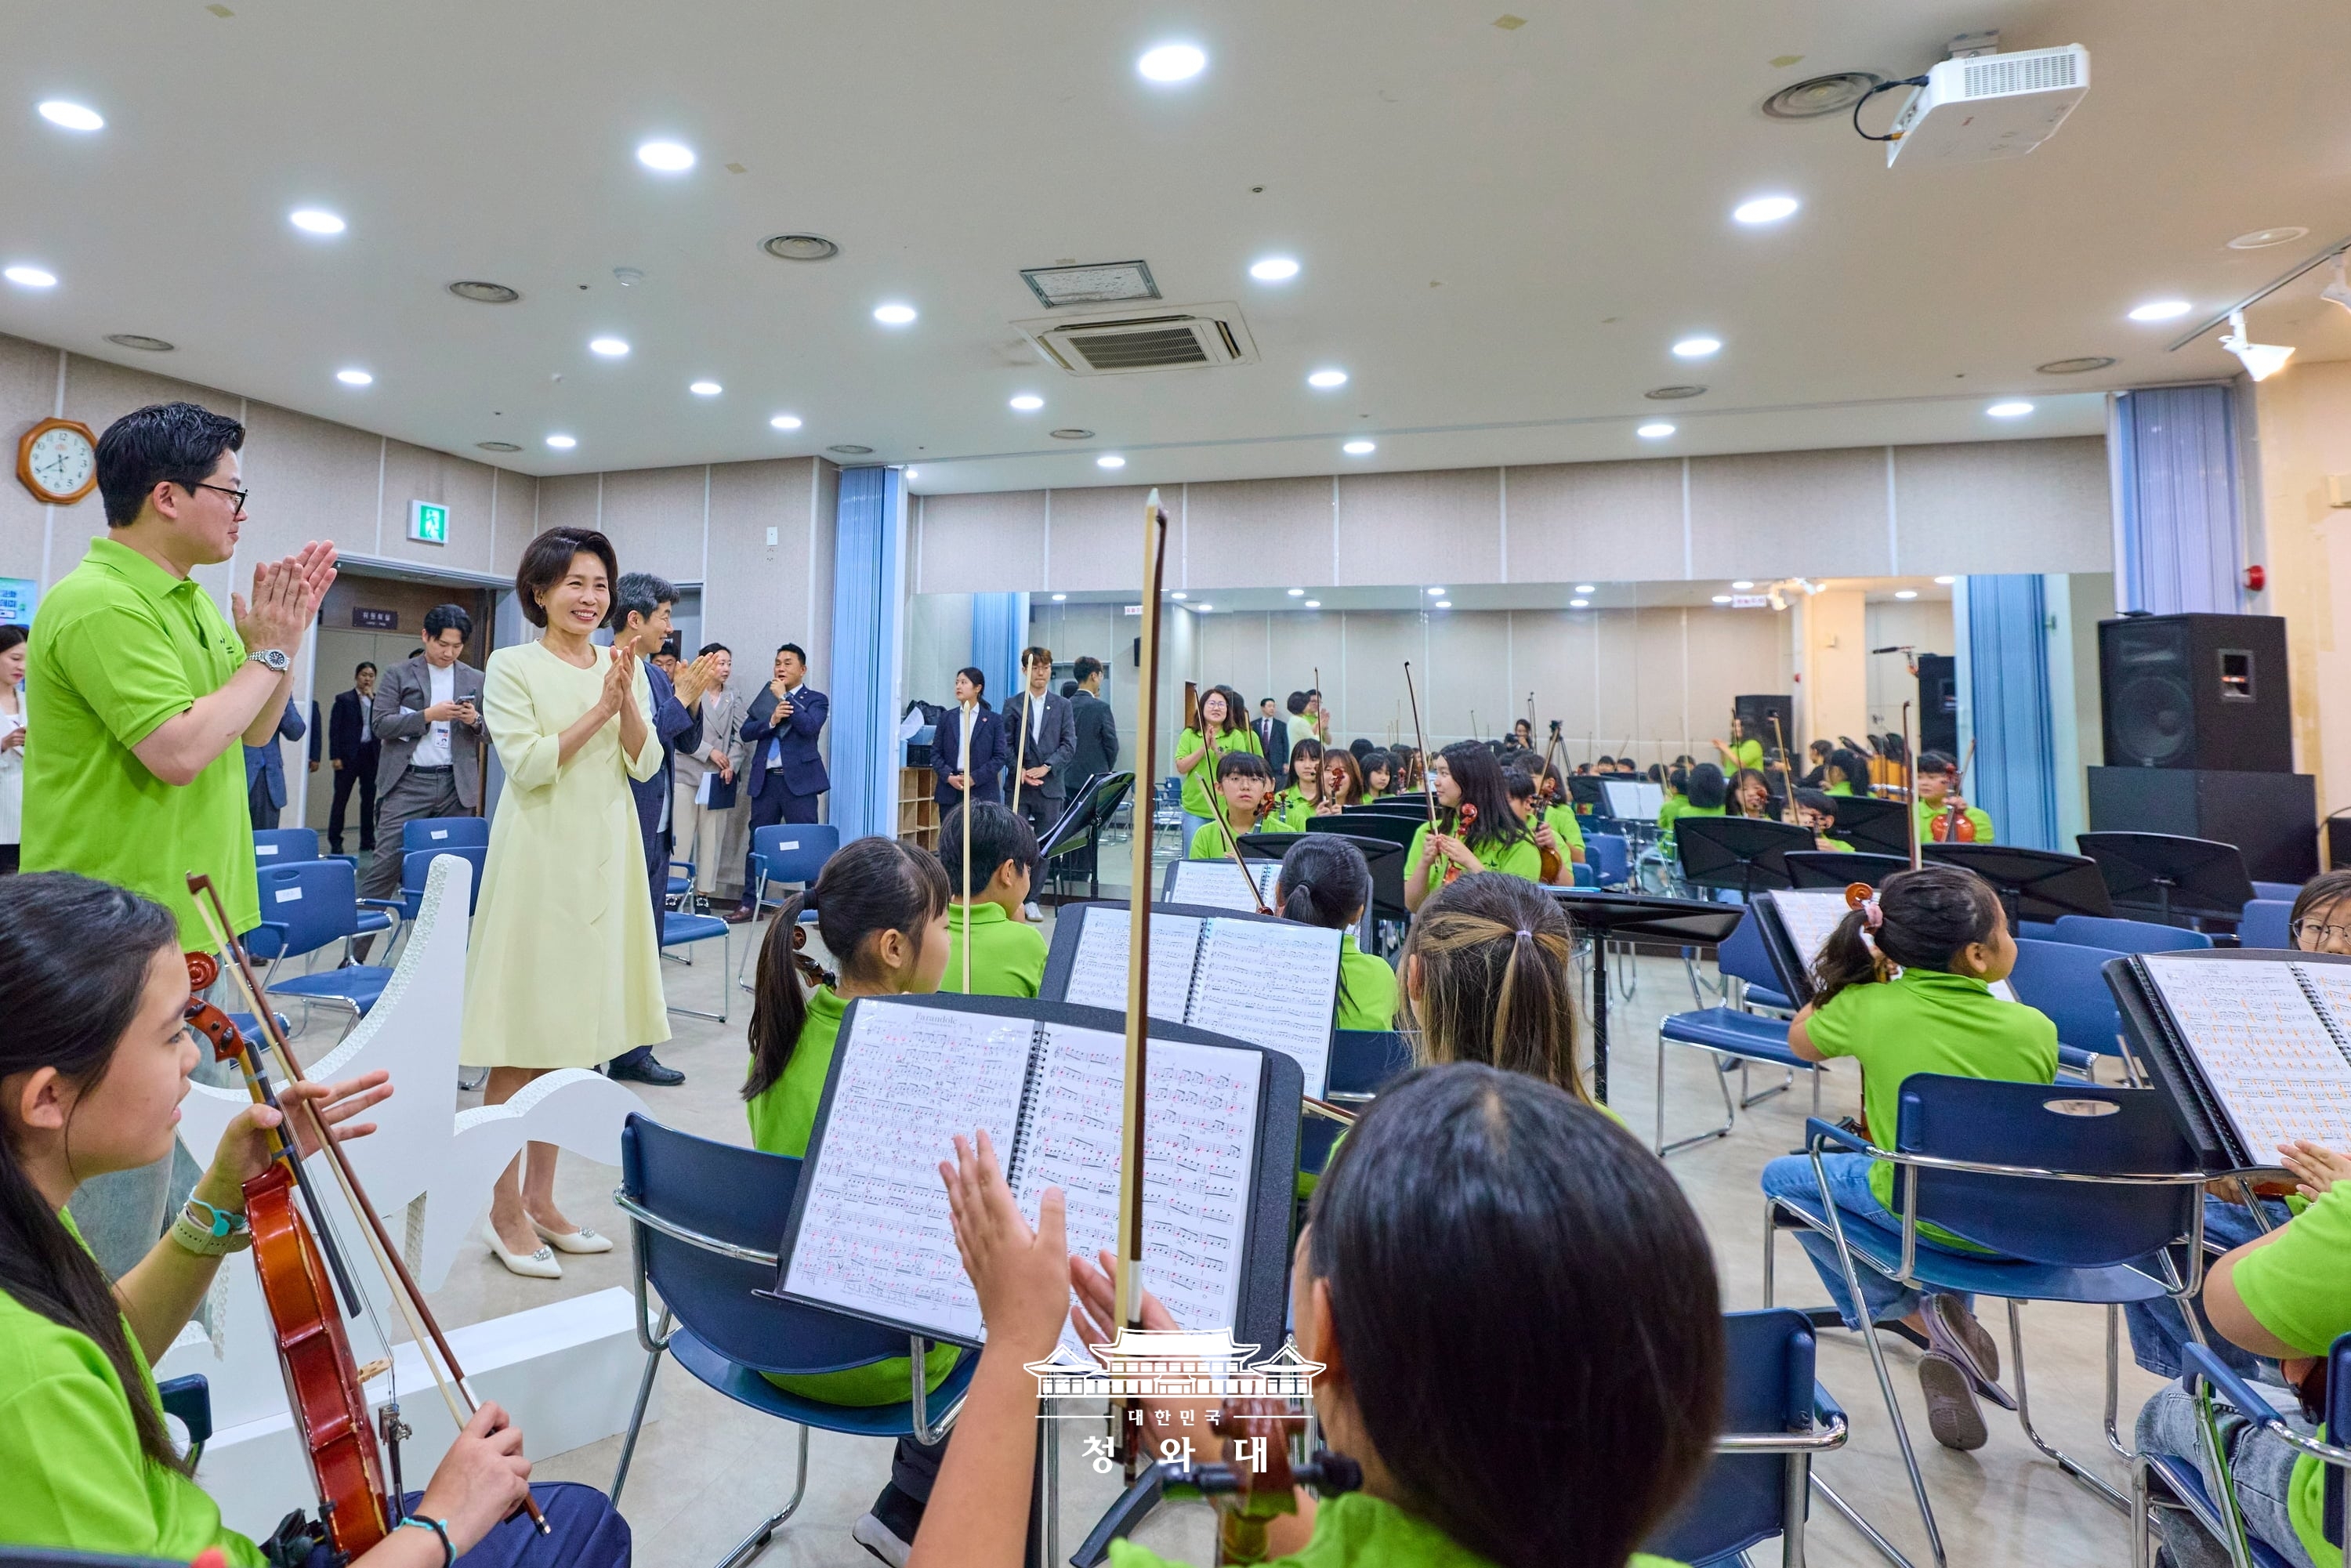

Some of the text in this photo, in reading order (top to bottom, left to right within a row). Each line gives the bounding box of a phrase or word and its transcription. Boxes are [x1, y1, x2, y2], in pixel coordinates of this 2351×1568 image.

[59, 432, 67, 440] 12
[79, 447, 85, 456] 2
[80, 459, 88, 468] 3
[67, 479, 74, 487] 5
[915, 1012, 958, 1025] Farandole
